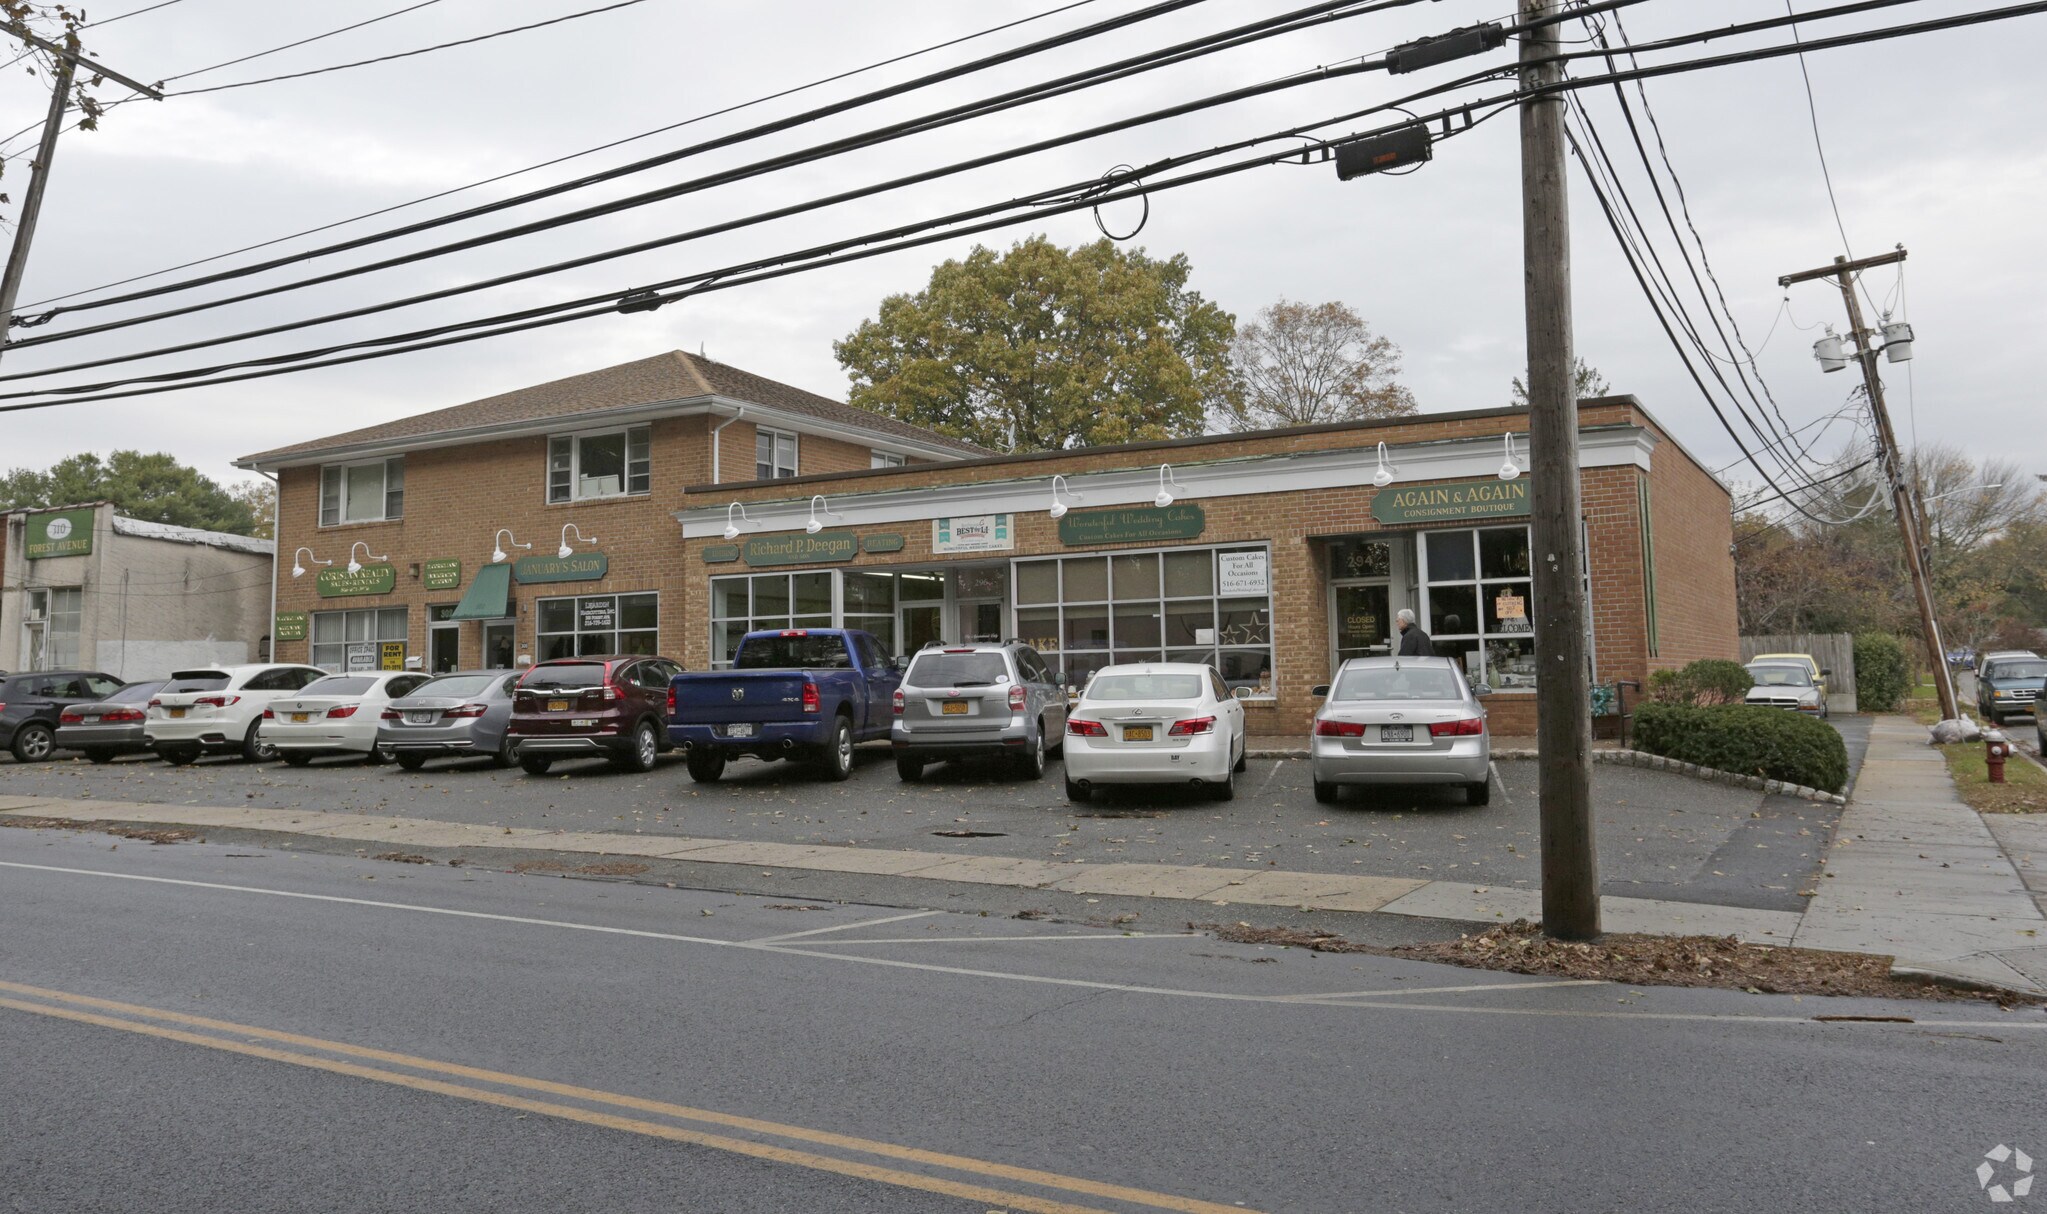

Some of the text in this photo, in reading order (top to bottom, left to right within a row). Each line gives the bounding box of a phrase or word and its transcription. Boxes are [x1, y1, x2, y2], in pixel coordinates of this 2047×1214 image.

[1393, 484, 1525, 507] AGAIN & AGAIN
[1404, 503, 1516, 518] CONSIGNMENT BOUTIQUE
[1121, 512, 1162, 528] Wedding
[1167, 509, 1195, 521] Cakes
[956, 526, 974, 536] BEST
[1149, 528, 1182, 536] Occasions
[29, 540, 88, 554] FOREST AVENUE
[750, 540, 793, 556] Richard
[805, 538, 850, 555] Deegan
[867, 538, 898, 547] HEATING
[520, 560, 600, 576] JANUARY'S SALON
[1347, 556, 1374, 568] 294
[360, 567, 391, 578] REALTY
[1491, 624, 1532, 633] WELCOME
[1028, 638, 1058, 652] AKE
